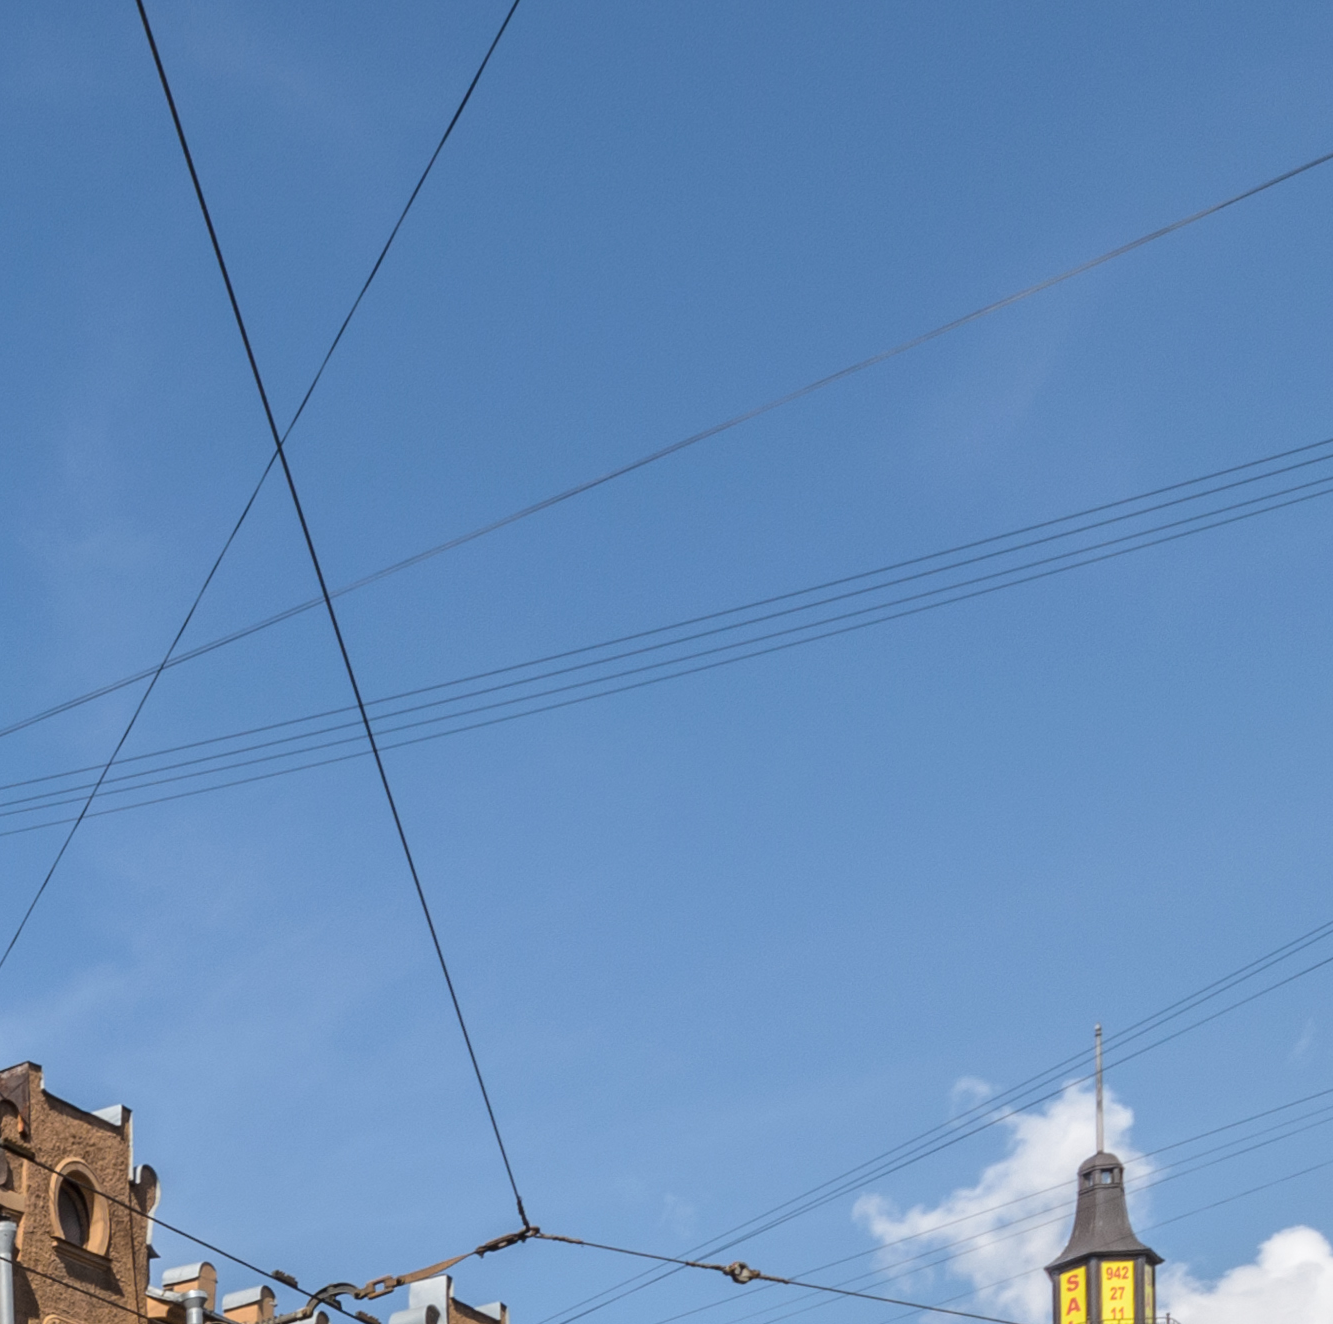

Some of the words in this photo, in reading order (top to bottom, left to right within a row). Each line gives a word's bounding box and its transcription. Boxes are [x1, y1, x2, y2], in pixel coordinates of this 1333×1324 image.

[1106, 1266, 1129, 1281] 942
[1110, 1287, 1125, 1301] 27
[1110, 1306, 1125, 1320] 11
